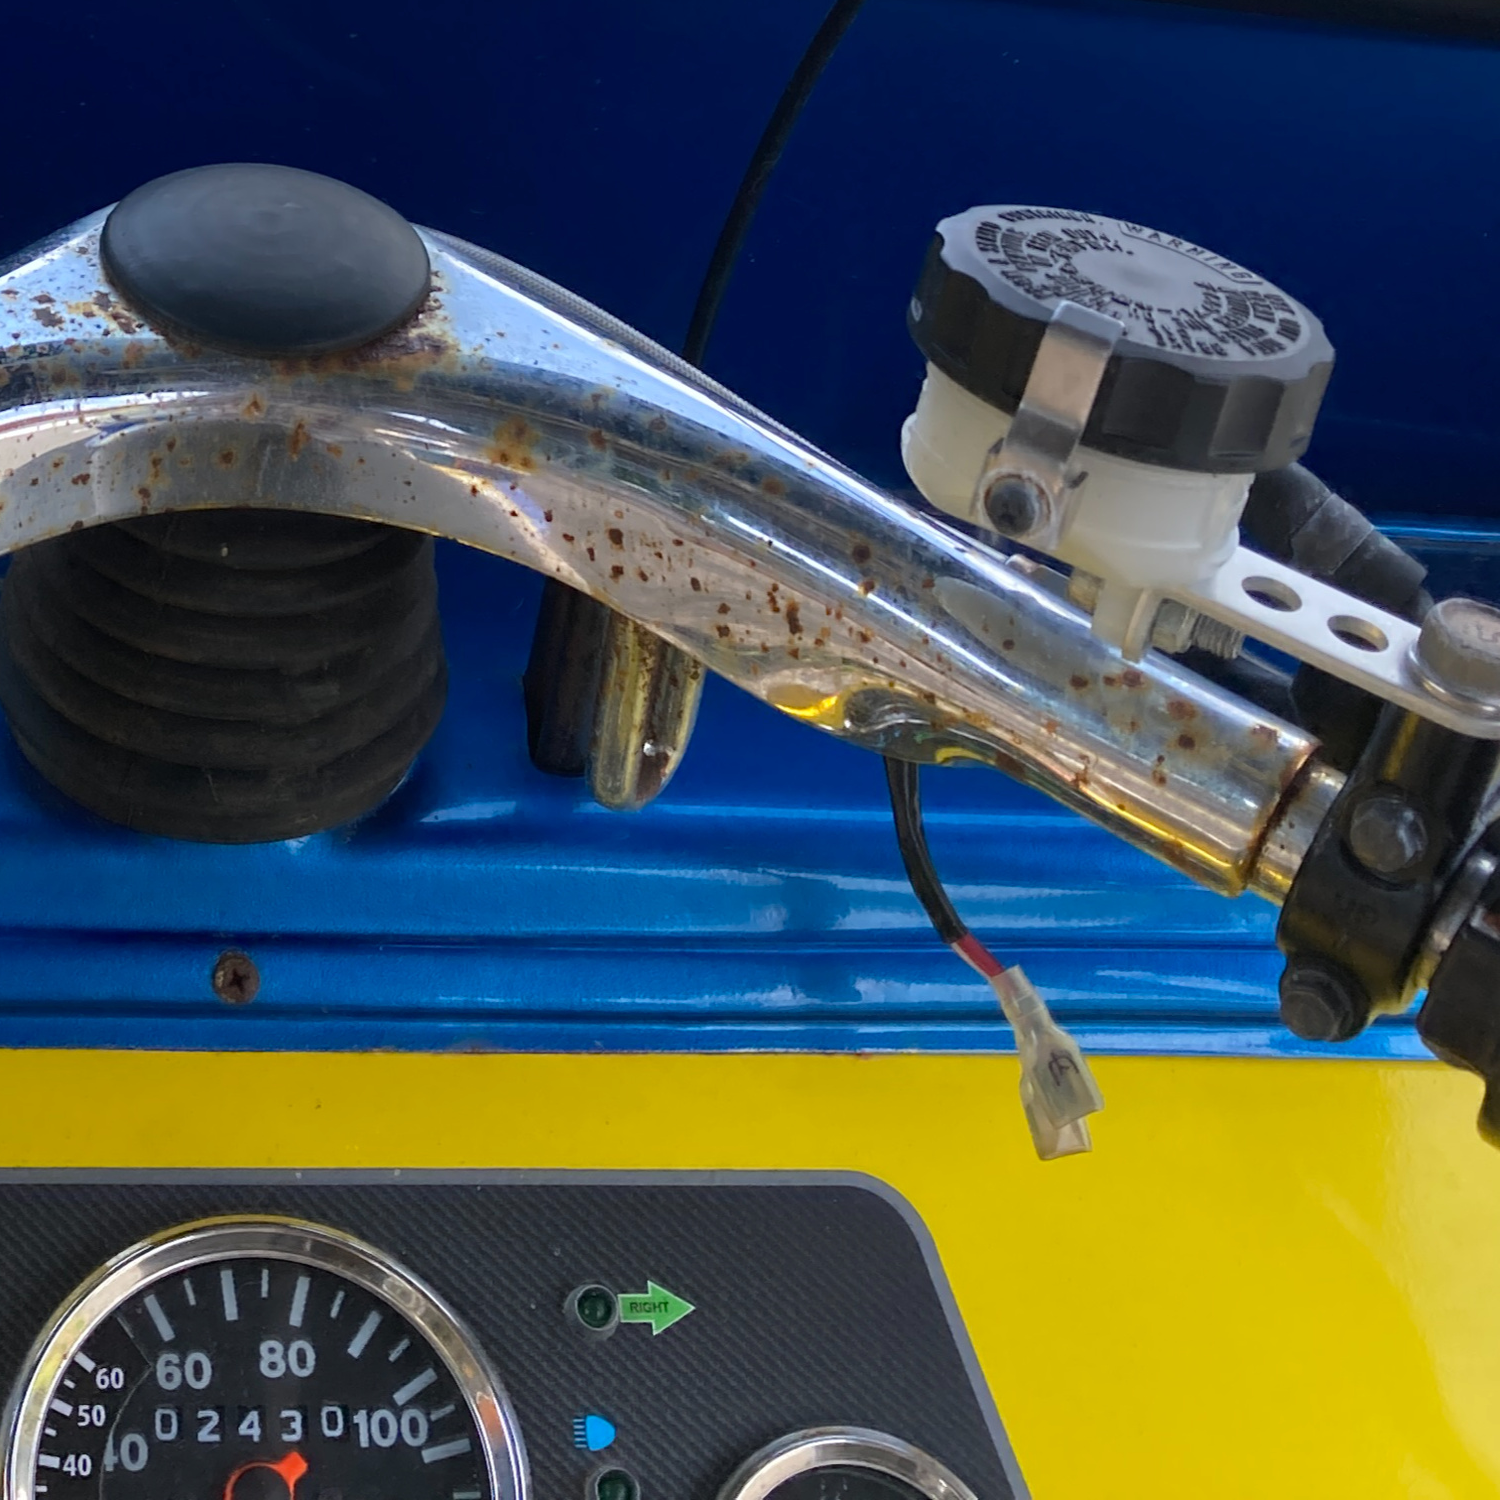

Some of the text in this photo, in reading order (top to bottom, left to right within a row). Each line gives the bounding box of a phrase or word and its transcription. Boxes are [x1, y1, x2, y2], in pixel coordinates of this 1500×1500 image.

[1124, 221, 1254, 281] WARNING
[629, 1301, 669, 1313] RIGHT
[156, 1352, 212, 1390] 60
[259, 1339, 316, 1378] 80
[95, 1367, 124, 1390] 60
[77, 1404, 106, 1427] 50
[353, 1408, 428, 1447] 100
[62, 1454, 92, 1476] 40
